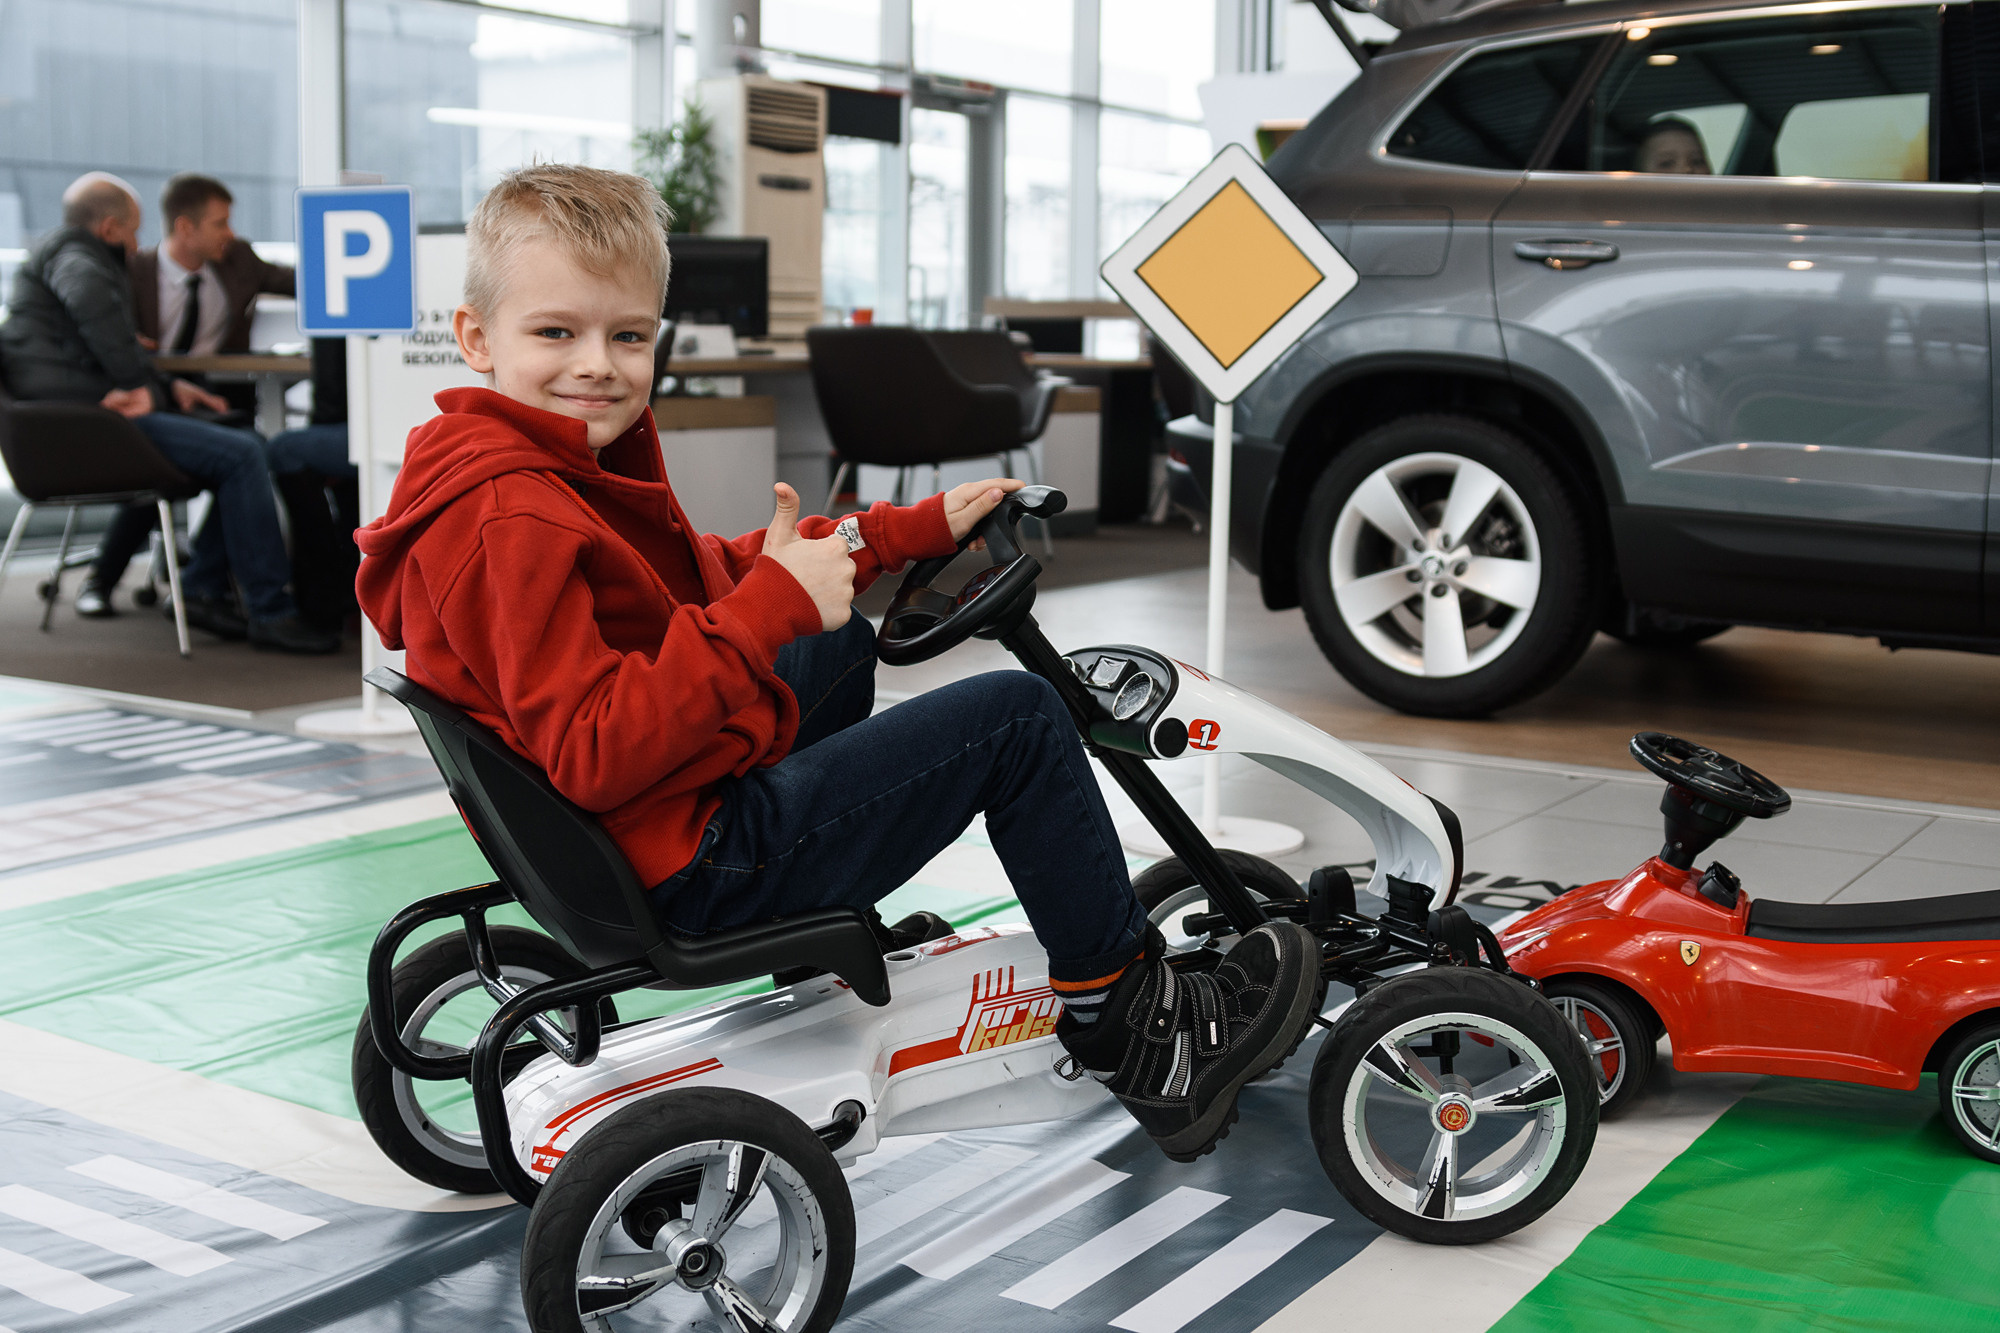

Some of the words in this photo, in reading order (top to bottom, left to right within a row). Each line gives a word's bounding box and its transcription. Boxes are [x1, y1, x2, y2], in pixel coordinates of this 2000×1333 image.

[323, 210, 393, 317] P
[401, 351, 468, 366] БЕЗОПА
[1200, 723, 1213, 747] 1
[968, 1010, 1058, 1053] kids
